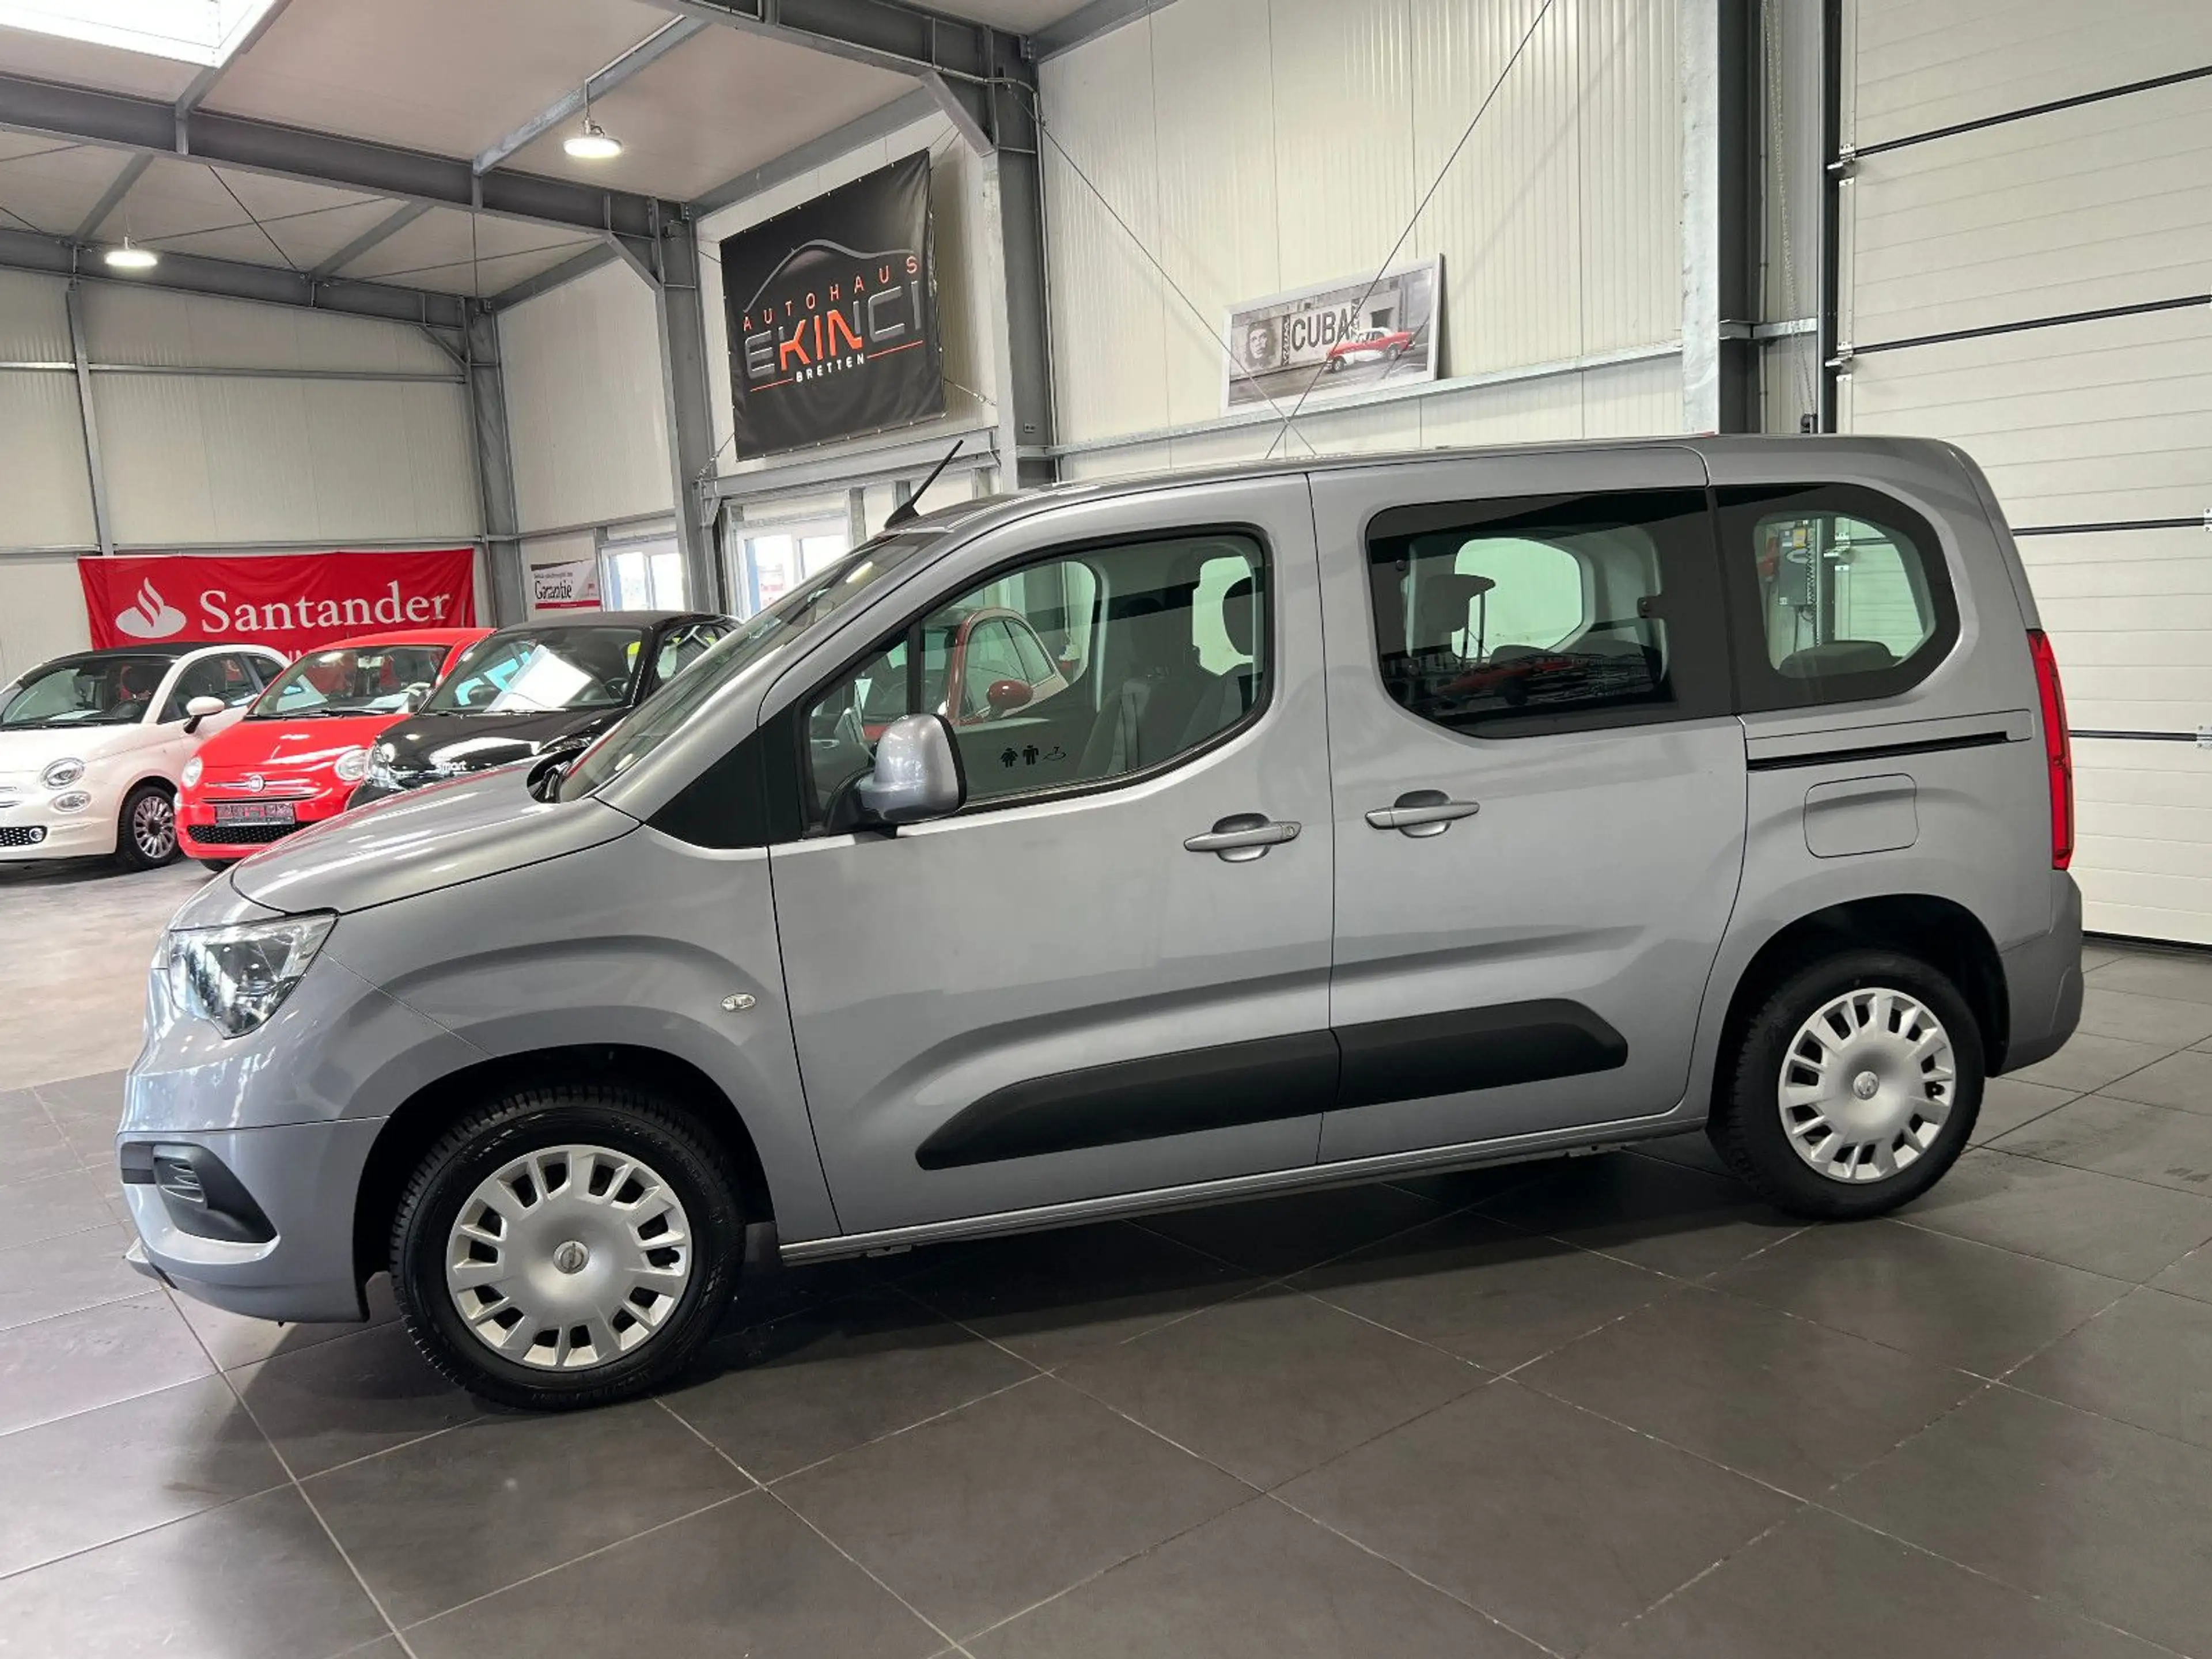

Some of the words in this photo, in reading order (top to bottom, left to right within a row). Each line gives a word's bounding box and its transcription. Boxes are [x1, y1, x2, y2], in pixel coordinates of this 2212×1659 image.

[743, 256, 918, 332] AUTOHAUS
[745, 281, 922, 380] EKINCI
[1291, 308, 1351, 352] CUBA
[796, 353, 865, 383] BRETTEN
[200, 580, 450, 633] Santander
